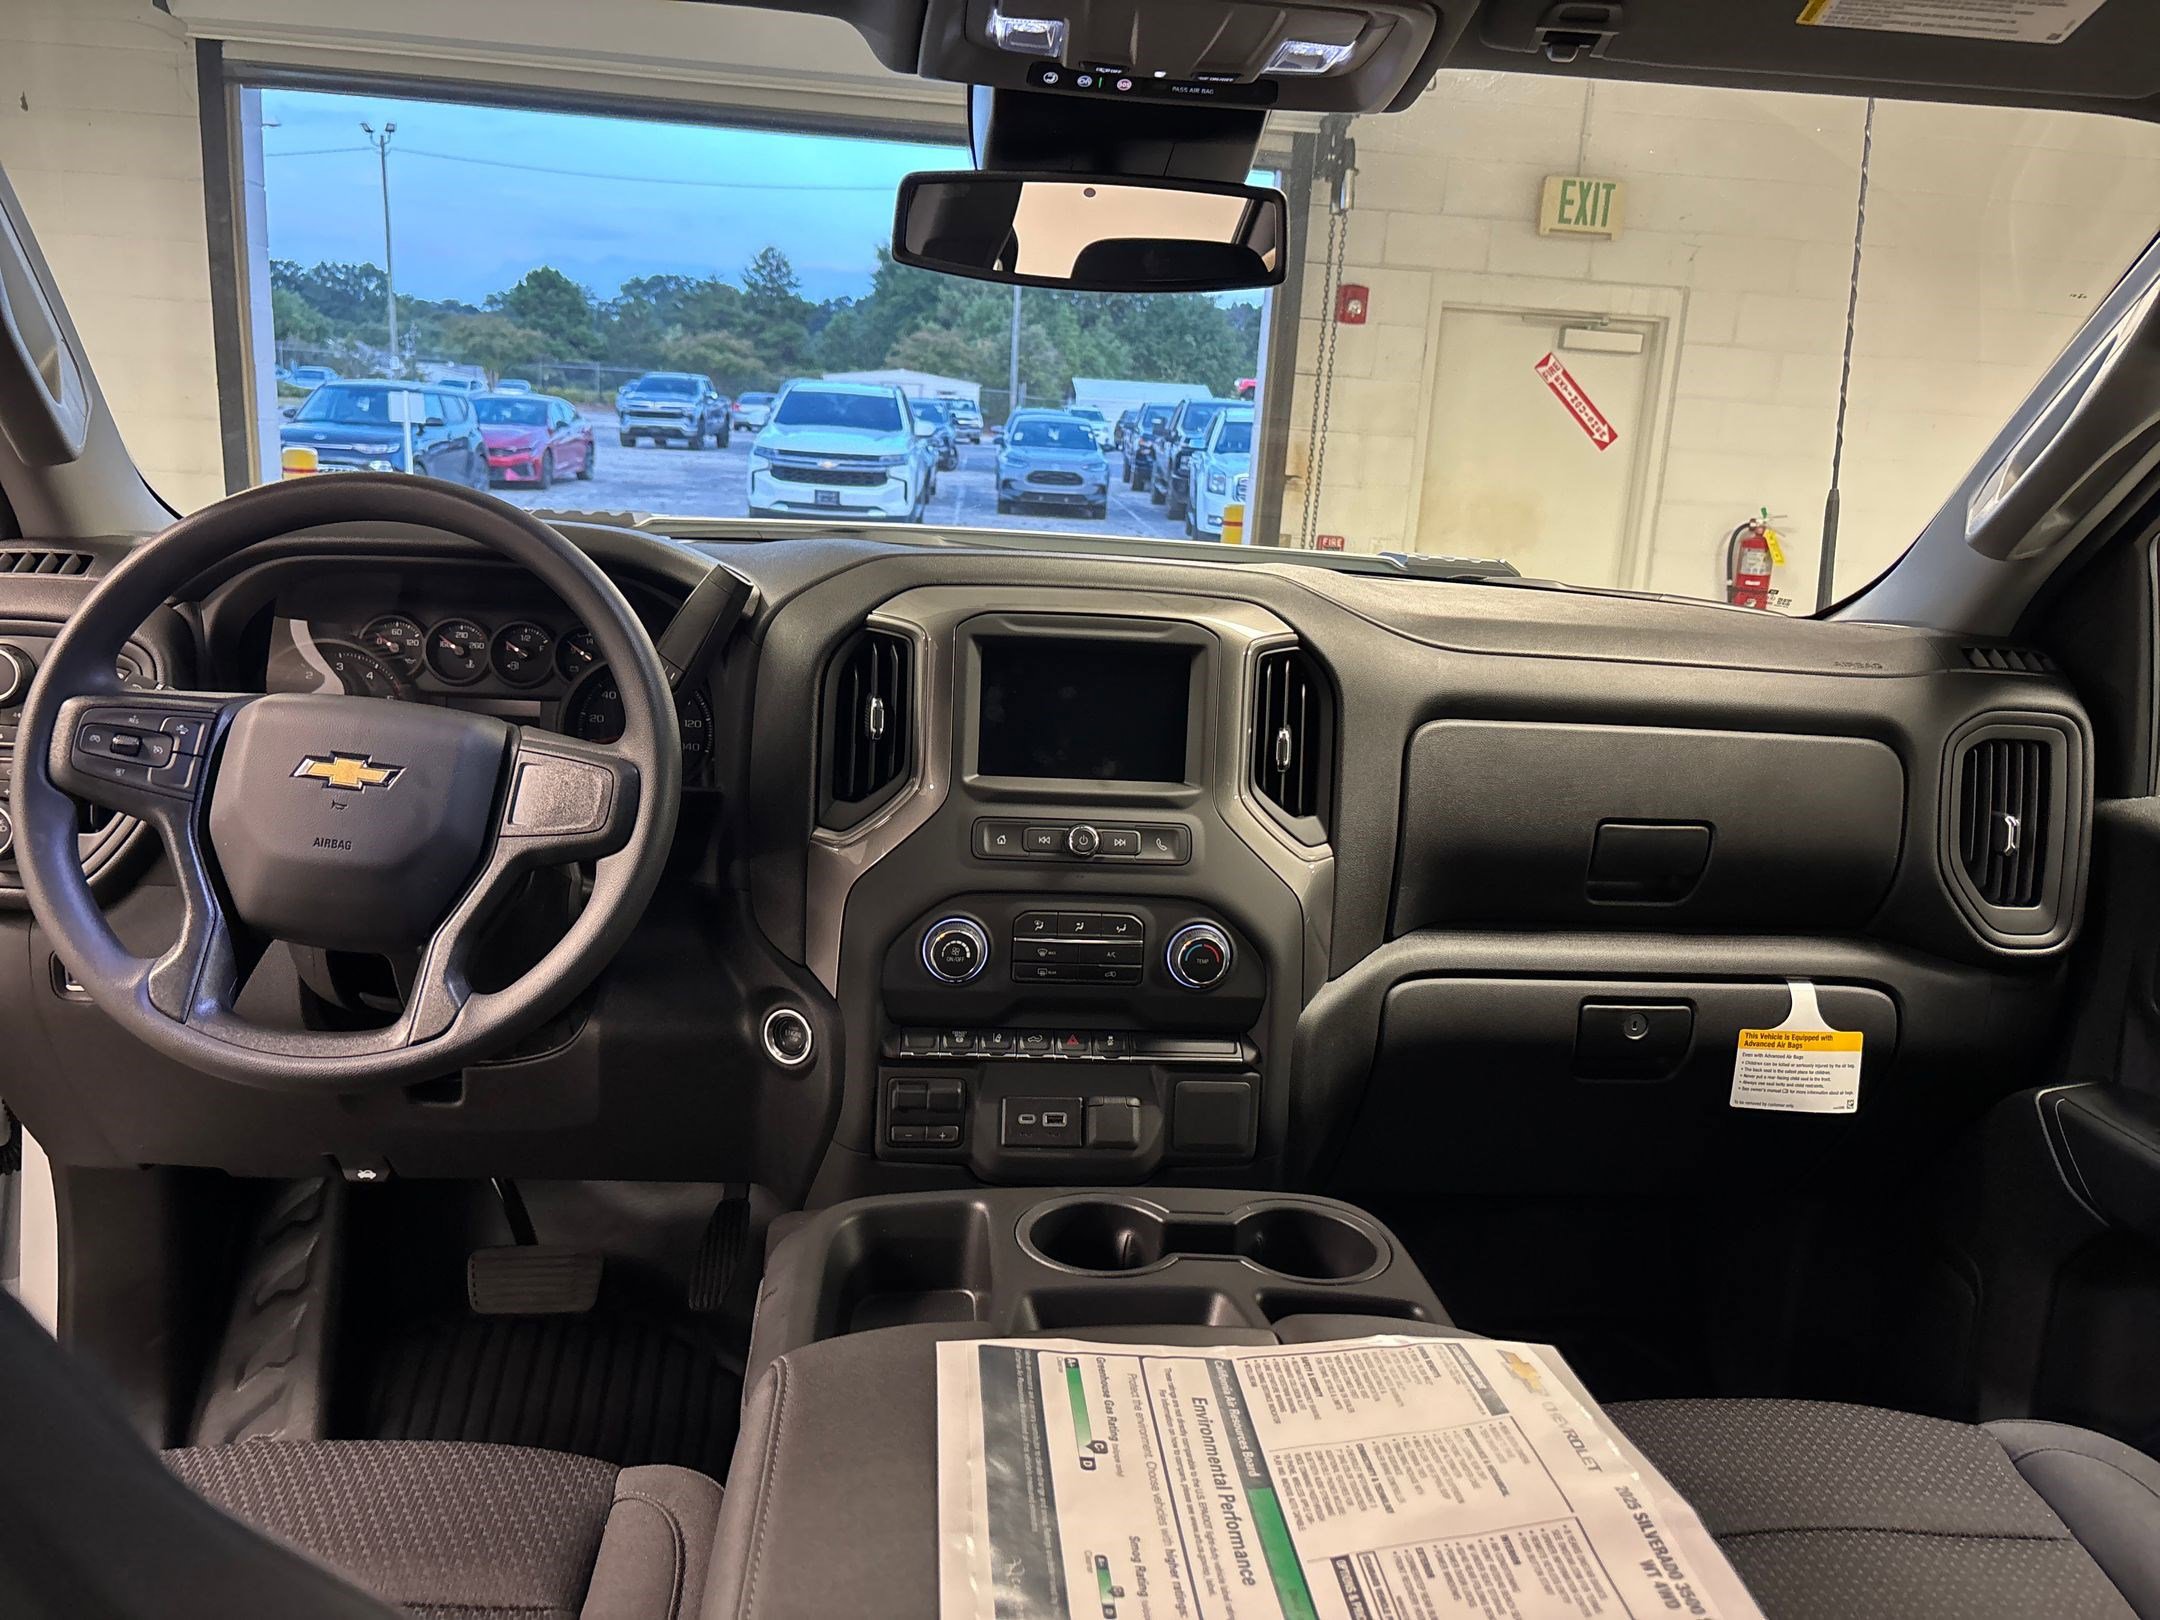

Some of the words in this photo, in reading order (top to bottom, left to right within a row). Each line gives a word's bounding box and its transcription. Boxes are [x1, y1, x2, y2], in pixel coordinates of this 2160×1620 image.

[1558, 180, 1616, 227] EXIT
[1542, 362, 1560, 381] FIRE
[1322, 537, 1342, 546] FIRE
[602, 691, 616, 699] 40
[684, 720, 702, 728] 120
[313, 838, 352, 850] AIRBAG
[1095, 1356, 1112, 1397] Greenhouse
[1126, 1374, 1141, 1398] Protect
[1212, 1360, 1233, 1394] California
[1103, 1400, 1116, 1413] Gas
[1131, 1399, 1144, 1409] the
[1223, 1396, 1238, 1407] Air
[1104, 1416, 1121, 1441] Rating
[1134, 1413, 1155, 1457] environment.
[1227, 1408, 1252, 1450] Resources
[1145, 1461, 1162, 1491] Choose
[1241, 1451, 1260, 1476] Board
[1191, 1397, 1233, 1489] Environmental
[1217, 1494, 1260, 1585] Performance
[1152, 1493, 1170, 1525] vehicles
[1125, 1535, 1144, 1562] Smog
[1160, 1528, 1175, 1546] with
[1614, 1486, 1641, 1510] 2025
[1631, 1514, 1685, 1581] SILVERADO
[1674, 1583, 1707, 1615] 3500
[1162, 1548, 1183, 1578] higher
[1130, 1565, 1151, 1597] Rating
[1638, 1559, 1663, 1579] WT
[1652, 1582, 1683, 1610] 4WD
[1169, 1581, 1192, 1617] ratings:
